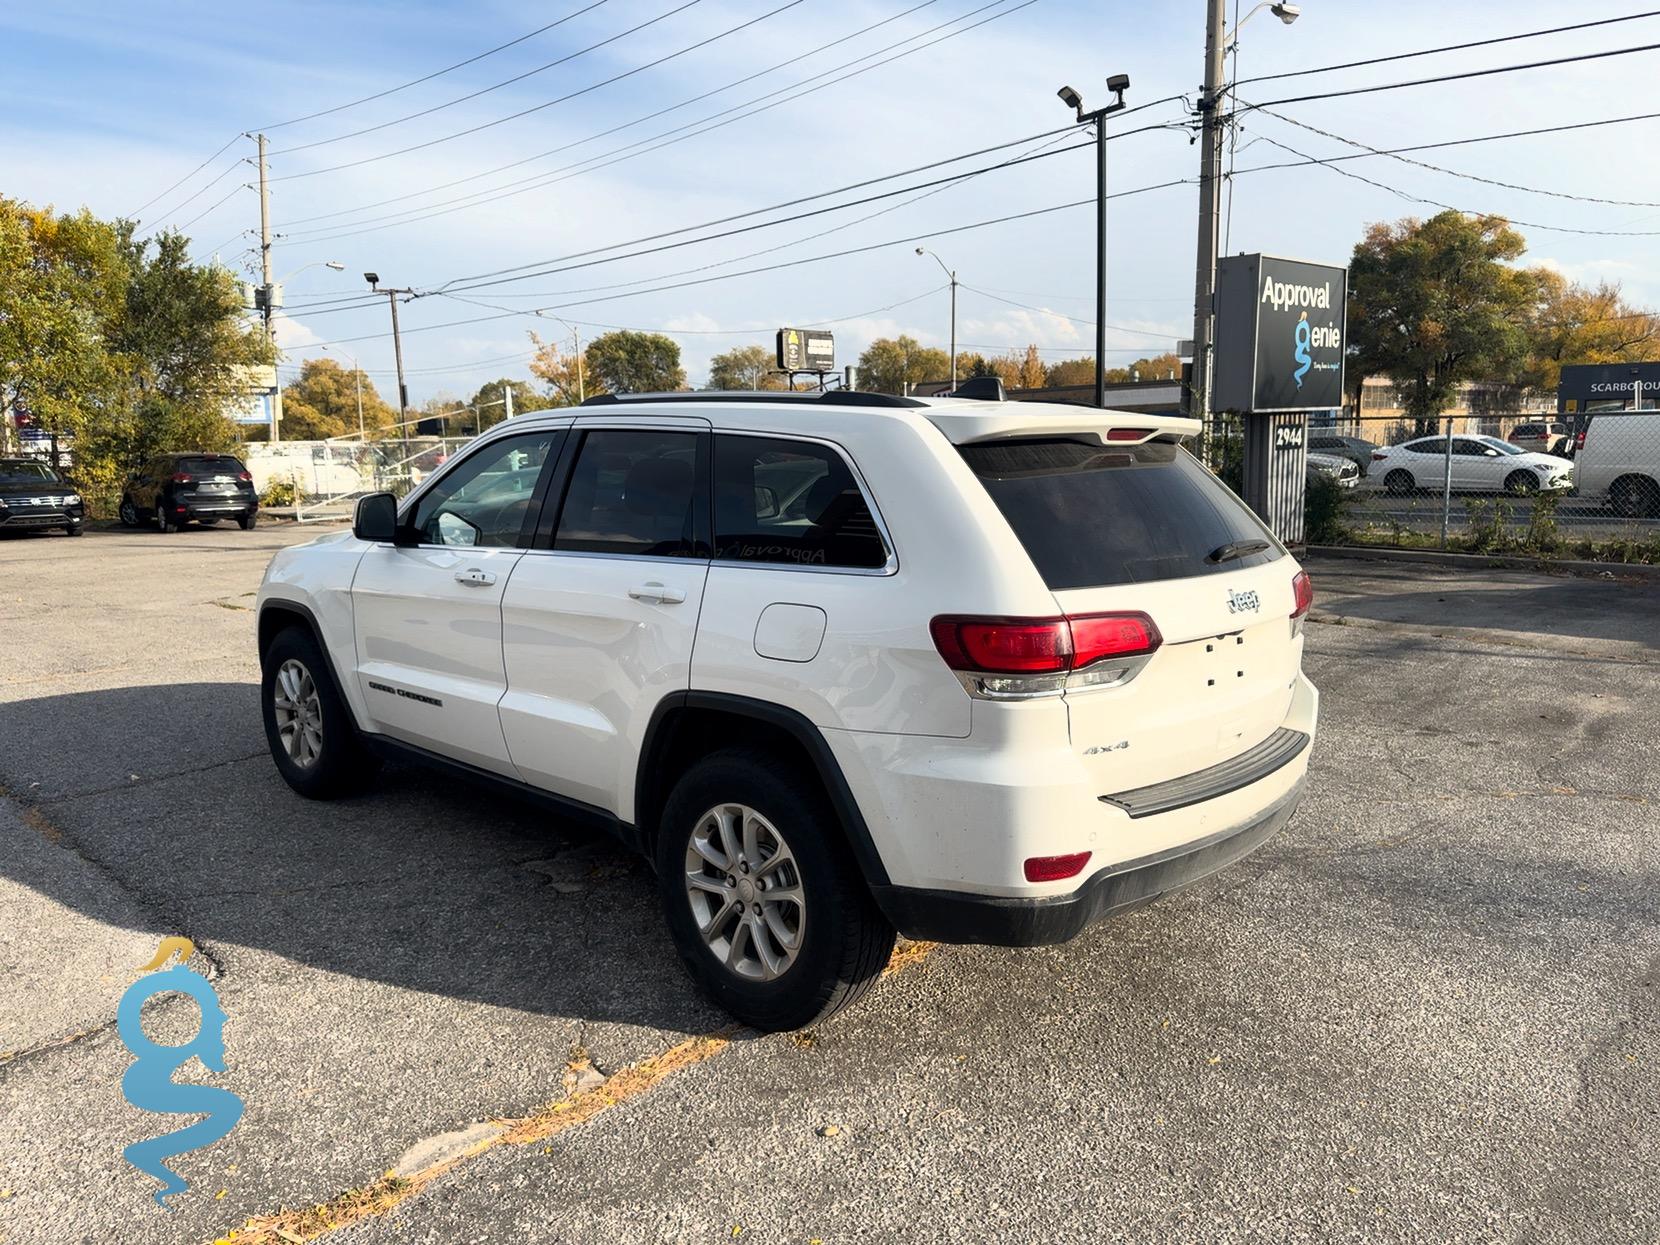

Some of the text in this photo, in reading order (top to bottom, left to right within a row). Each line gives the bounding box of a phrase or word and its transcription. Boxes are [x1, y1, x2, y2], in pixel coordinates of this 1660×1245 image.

[1261, 276, 1330, 312] Approval
[1590, 381, 1660, 393] SCARBOOU
[1276, 427, 1303, 446] 2944
[1226, 588, 1261, 614] Jeep
